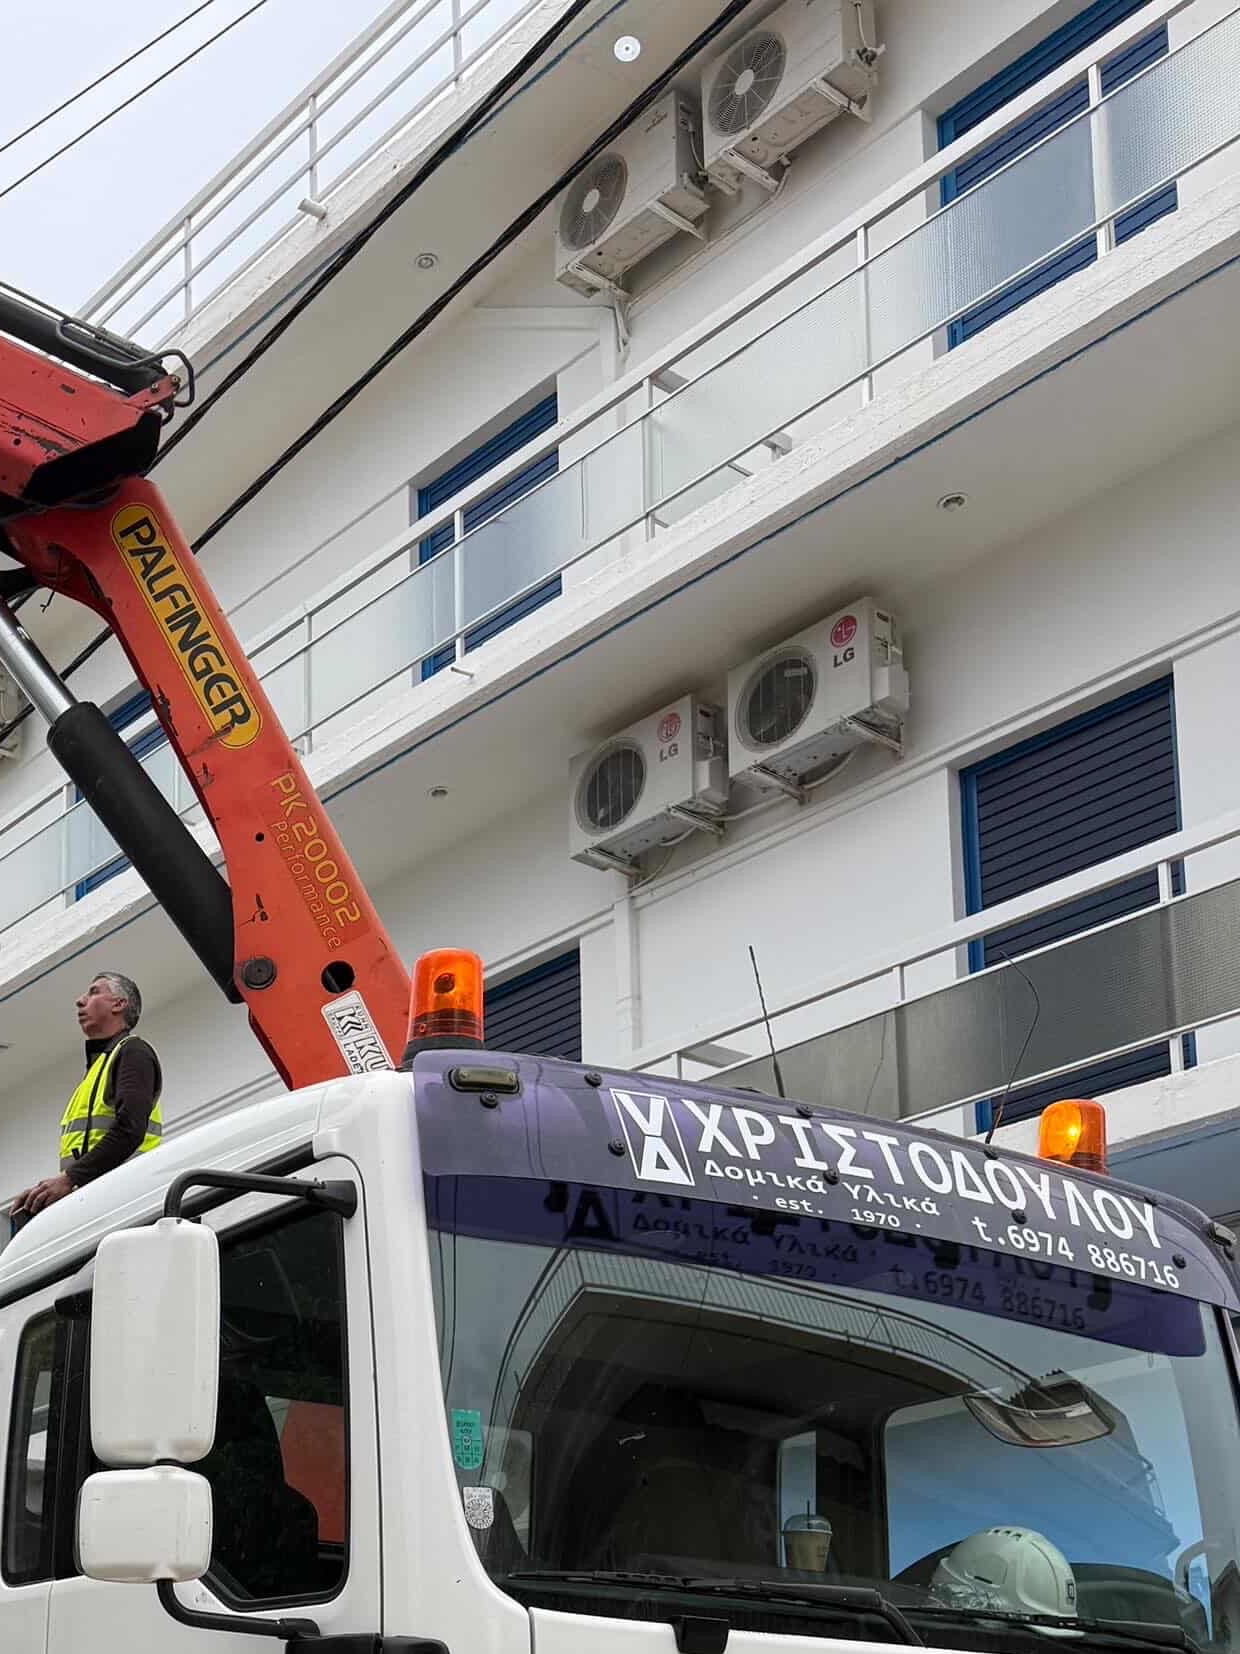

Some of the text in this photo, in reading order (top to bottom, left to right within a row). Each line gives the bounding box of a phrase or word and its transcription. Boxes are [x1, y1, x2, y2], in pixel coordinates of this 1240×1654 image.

[119, 516, 251, 729] PALFINGER
[833, 648, 855, 668] LG
[660, 744, 678, 762] LG
[271, 773, 361, 927] PK 20002
[272, 820, 341, 951] Performance
[681, 1099, 1162, 1249] ΧΡΙΣΤΟΔΟΥΛΟΥ
[704, 1159, 941, 1217] Δομικά Υλικά
[775, 1197, 900, 1228] est. 1970
[971, 1216, 1181, 1289] t.6974 886716
